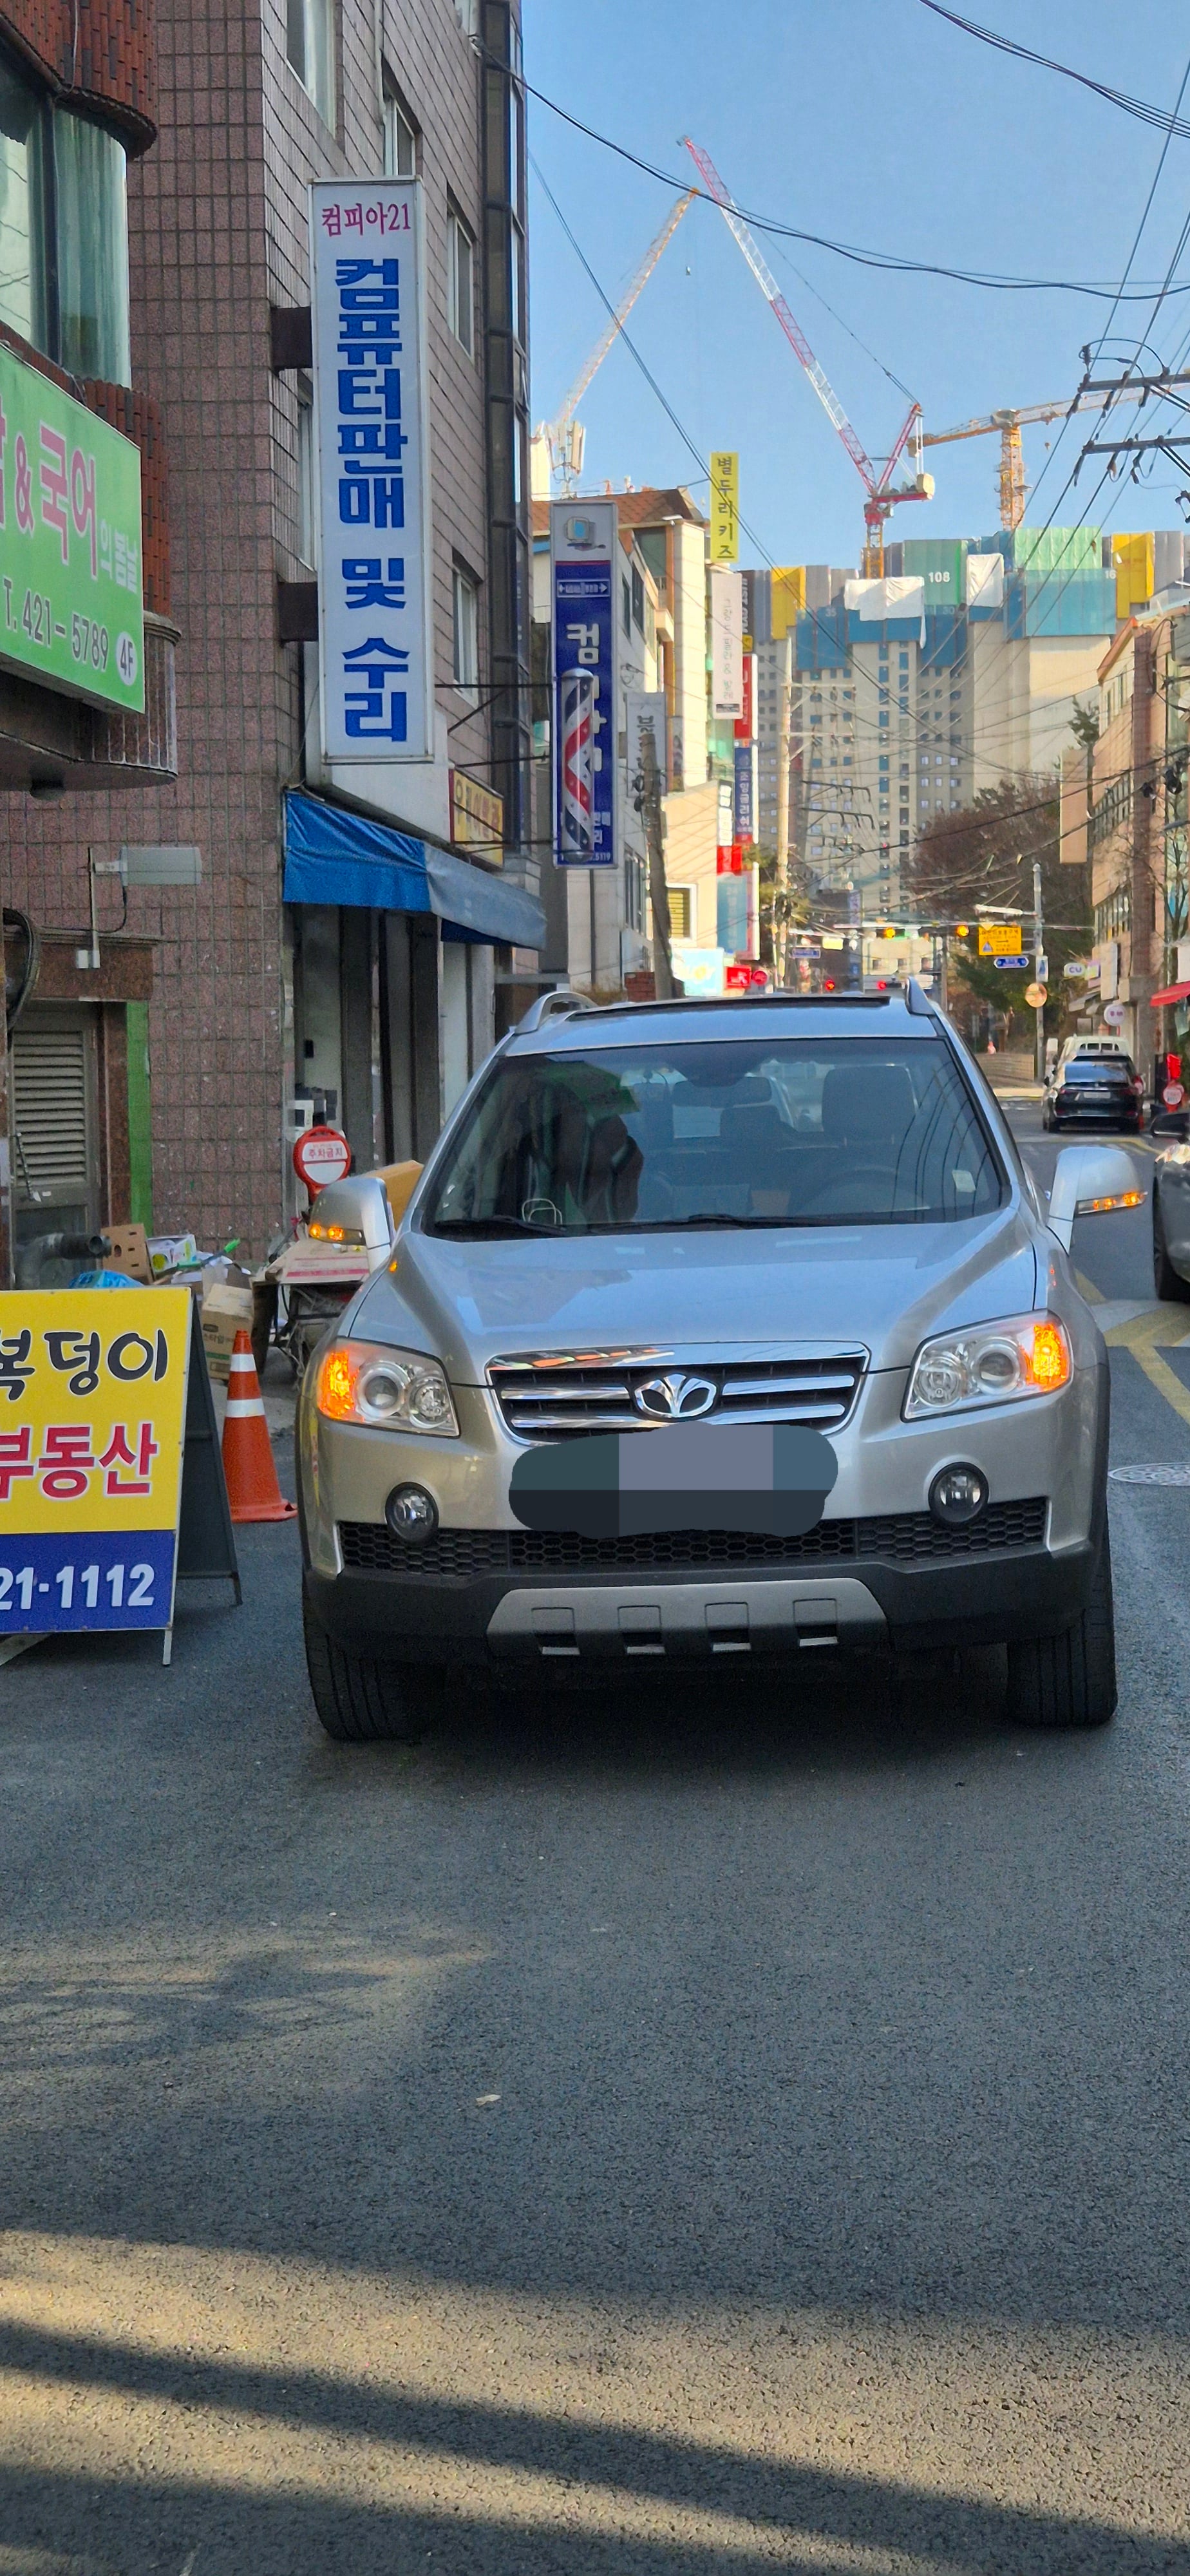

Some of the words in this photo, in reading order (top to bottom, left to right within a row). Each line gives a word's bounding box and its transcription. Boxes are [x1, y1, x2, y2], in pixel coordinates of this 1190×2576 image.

[322, 202, 411, 237] 컴피아21
[335, 258, 408, 529] 컴퓨터판매
[717, 456, 735, 559] 별두리키즈
[342, 558, 406, 609] 및
[929, 572, 950, 583] 108
[120, 638, 133, 678] 4F
[342, 638, 410, 742] 수리
[309, 1148, 343, 1159] 주차금지
